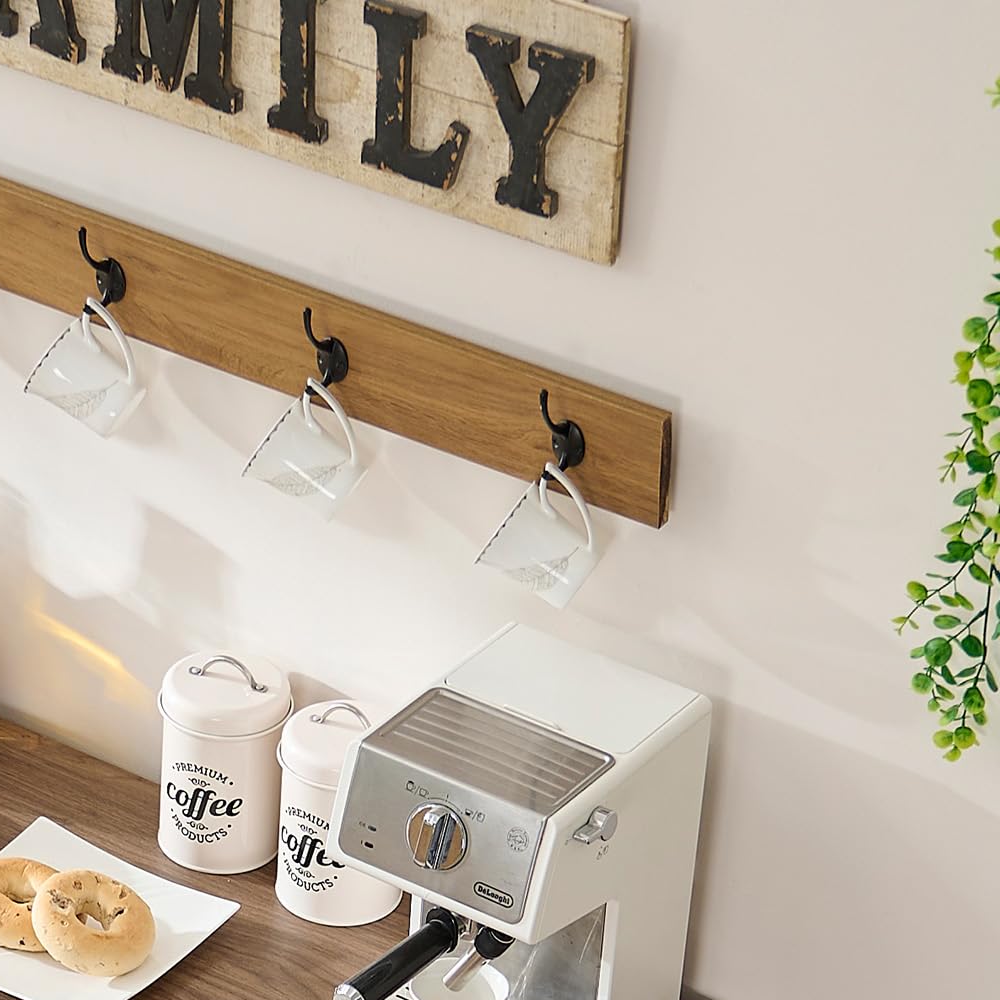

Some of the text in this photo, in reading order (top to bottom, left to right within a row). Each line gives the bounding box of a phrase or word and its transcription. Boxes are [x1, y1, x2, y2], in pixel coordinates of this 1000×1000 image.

[175, 762, 228, 784] PREMIUM
[166, 781, 243, 820] Coffee
[171, 814, 228, 843] PRODUCTS
[281, 825, 346, 868] Coffe
[283, 859, 334, 892] PRODUCTS
[477, 884, 510, 905] DeLonghi
